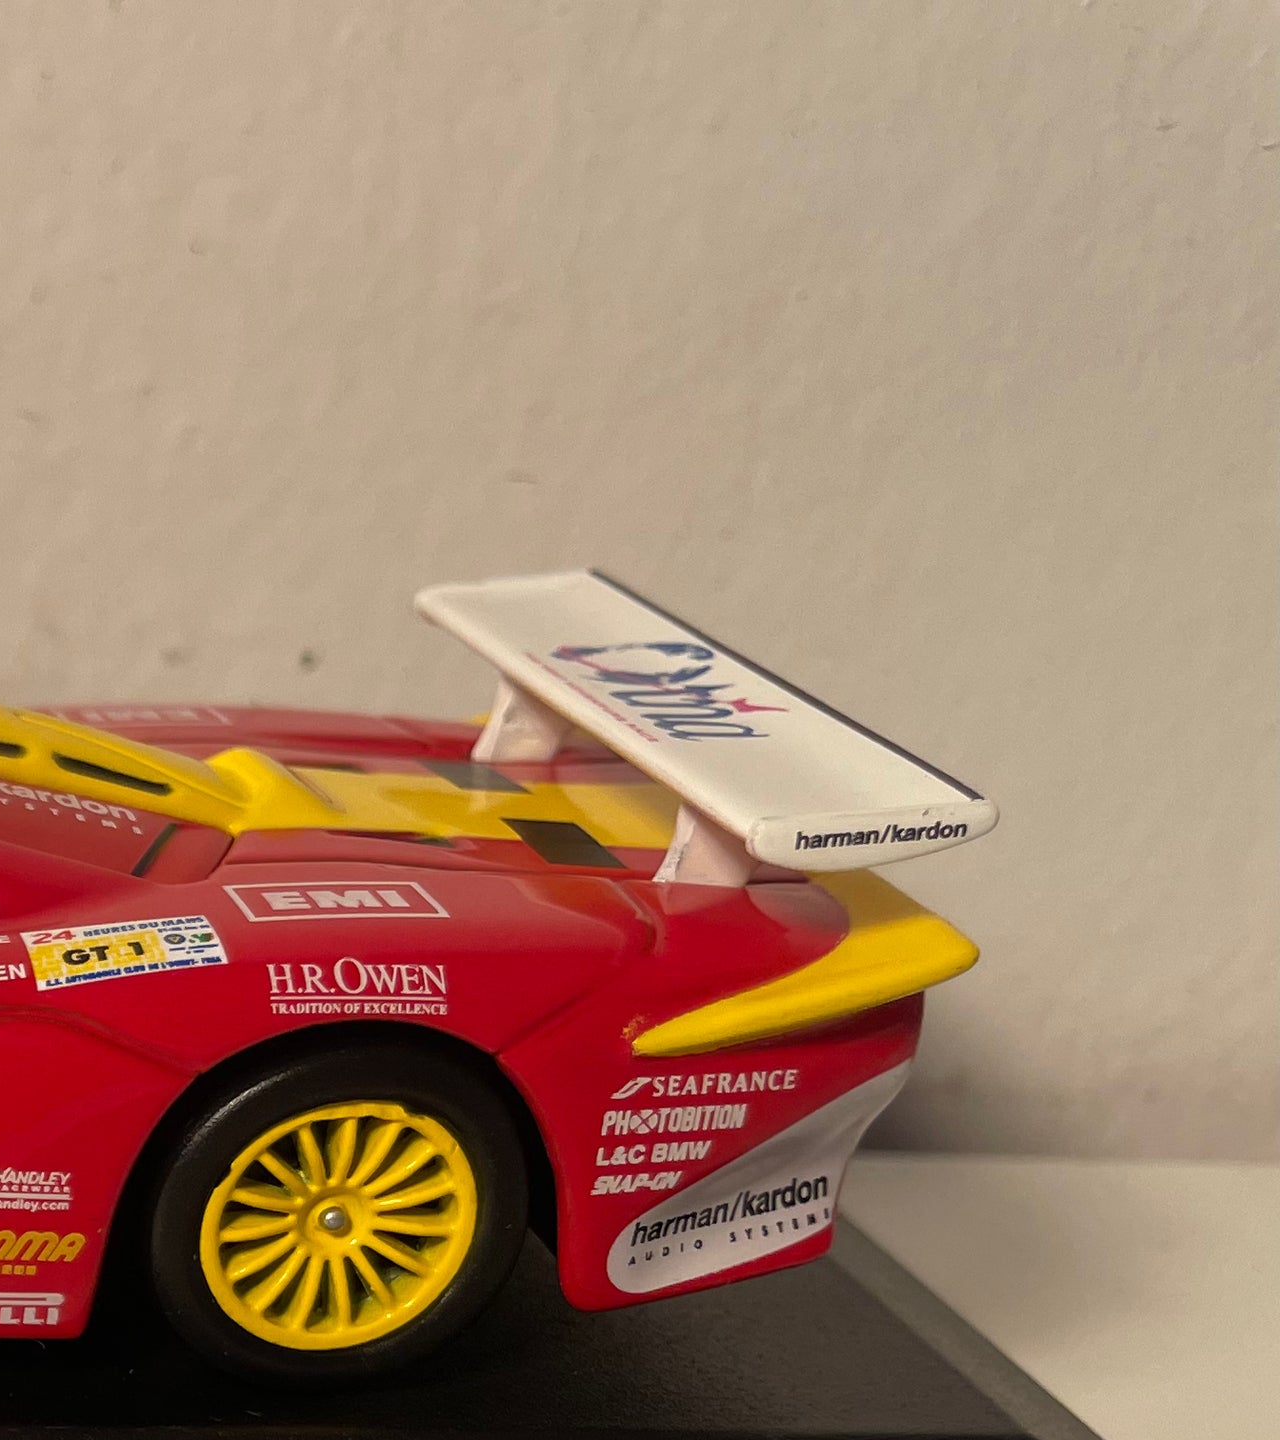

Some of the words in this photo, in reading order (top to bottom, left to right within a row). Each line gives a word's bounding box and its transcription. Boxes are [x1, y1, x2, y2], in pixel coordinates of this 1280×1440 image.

[794, 820, 968, 850] harman/kardon
[261, 890, 411, 910] EMI
[31, 930, 77, 944] 24
[62, 945, 110, 966] GT
[127, 941, 146, 956] 1
[269, 1002, 341, 1015] TRADITION
[343, 1003, 361, 1015] OF
[363, 1003, 448, 1015] EXCELLENCE
[652, 1069, 799, 1097] SEAFRANCE
[596, 1146, 646, 1167] L&C
[651, 1140, 713, 1163] BMW
[630, 1174, 829, 1247] harman/kardon
[628, 1239, 703, 1267] AUDIO
